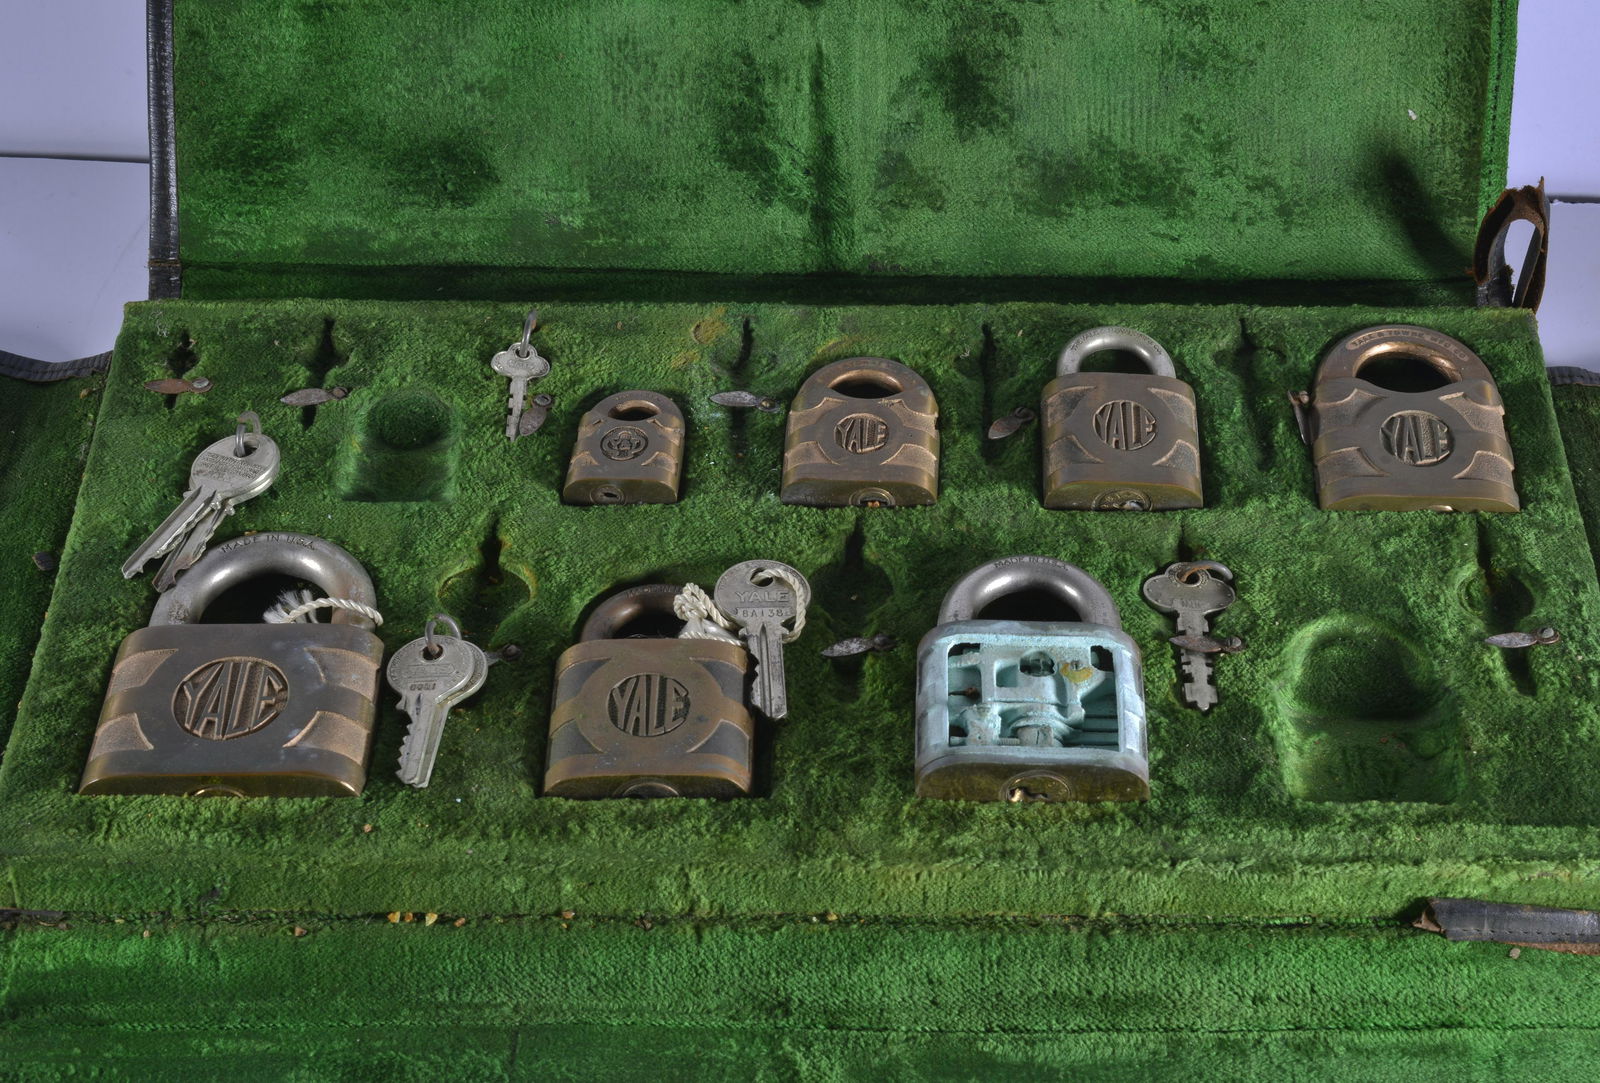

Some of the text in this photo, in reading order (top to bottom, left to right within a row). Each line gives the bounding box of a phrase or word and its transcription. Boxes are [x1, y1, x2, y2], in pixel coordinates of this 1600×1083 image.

[834, 415, 888, 454] YALE
[1092, 401, 1156, 450] YALE
[1380, 412, 1451, 466] YALE
[221, 535, 260, 553] MADE
[265, 534, 280, 544] IN
[735, 590, 789, 603] YALE
[177, 658, 286, 740] YALE
[610, 674, 689, 737] YALE
